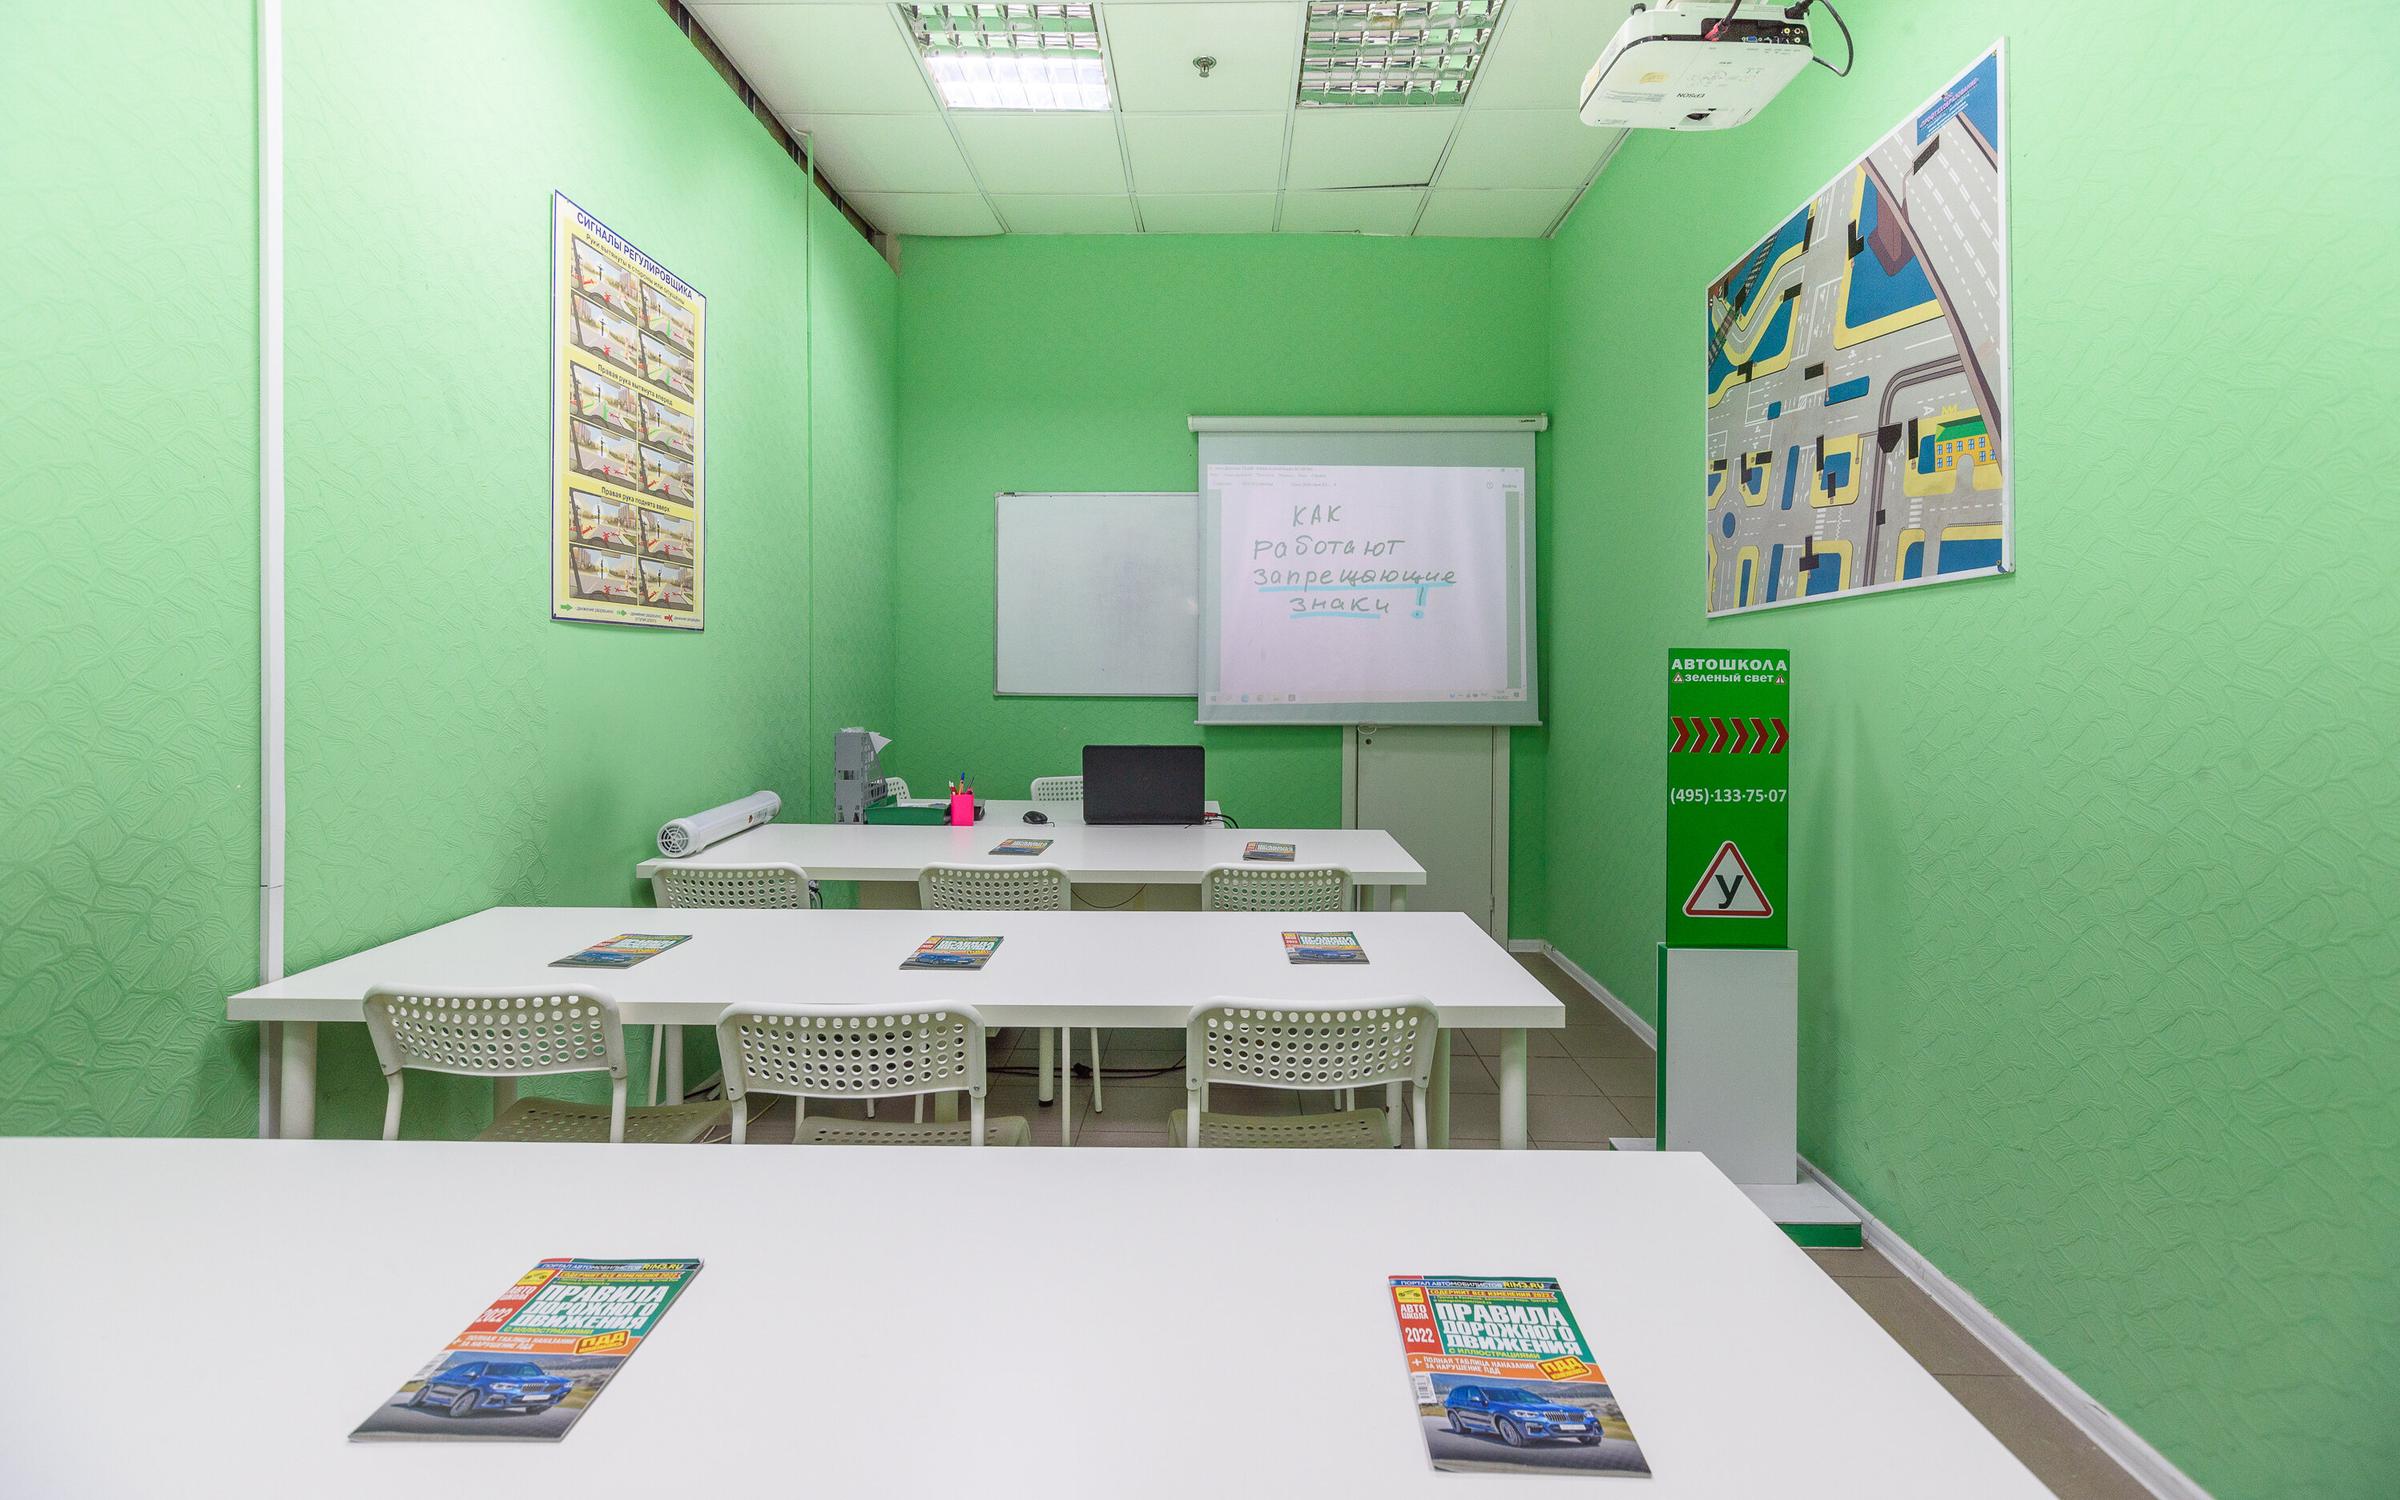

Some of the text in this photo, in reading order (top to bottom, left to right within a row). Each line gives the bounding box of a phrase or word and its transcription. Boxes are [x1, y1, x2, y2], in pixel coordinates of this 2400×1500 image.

[577, 212, 693, 300] СИГНАЛЫ РЕГУЛИРОВЩИКА
[597, 363, 618, 379] Правая
[601, 486, 622, 498] Правая
[622, 493, 634, 503] рука
[1293, 504, 1342, 527] КАК
[1671, 659, 1787, 671] АВТОШКОЛА
[1685, 673, 1774, 682] зеленый свет
[1503, 1281, 1544, 1289] RIM3.RU
[540, 1285, 669, 1302] ПРАВИЛА
[479, 1308, 513, 1322] 2022
[524, 1301, 659, 1316] ДОРОЖНОГО
[1400, 1304, 1427, 1313] АВТО
[1435, 1303, 1569, 1326] ПРАВИЛА
[510, 1313, 648, 1329] ДВИЖЕНИЯ
[1405, 1328, 1435, 1343] 2022
[1442, 1320, 1575, 1342] ДОРОЖНОГО
[582, 1332, 625, 1346] ПДД
[1446, 1334, 1583, 1355] ДВИЖЕНИЯ
[1458, 1348, 1541, 1359] ИЛЛЮСТРАЦИЯМИ
[1423, 1356, 1453, 1364] ПОЛНАЯ
[1455, 1358, 1490, 1367] ТАБЛИЦА
[1436, 1364, 1481, 1372] НАРУШЕНИЕ
[1544, 1357, 1581, 1373] ПДД
